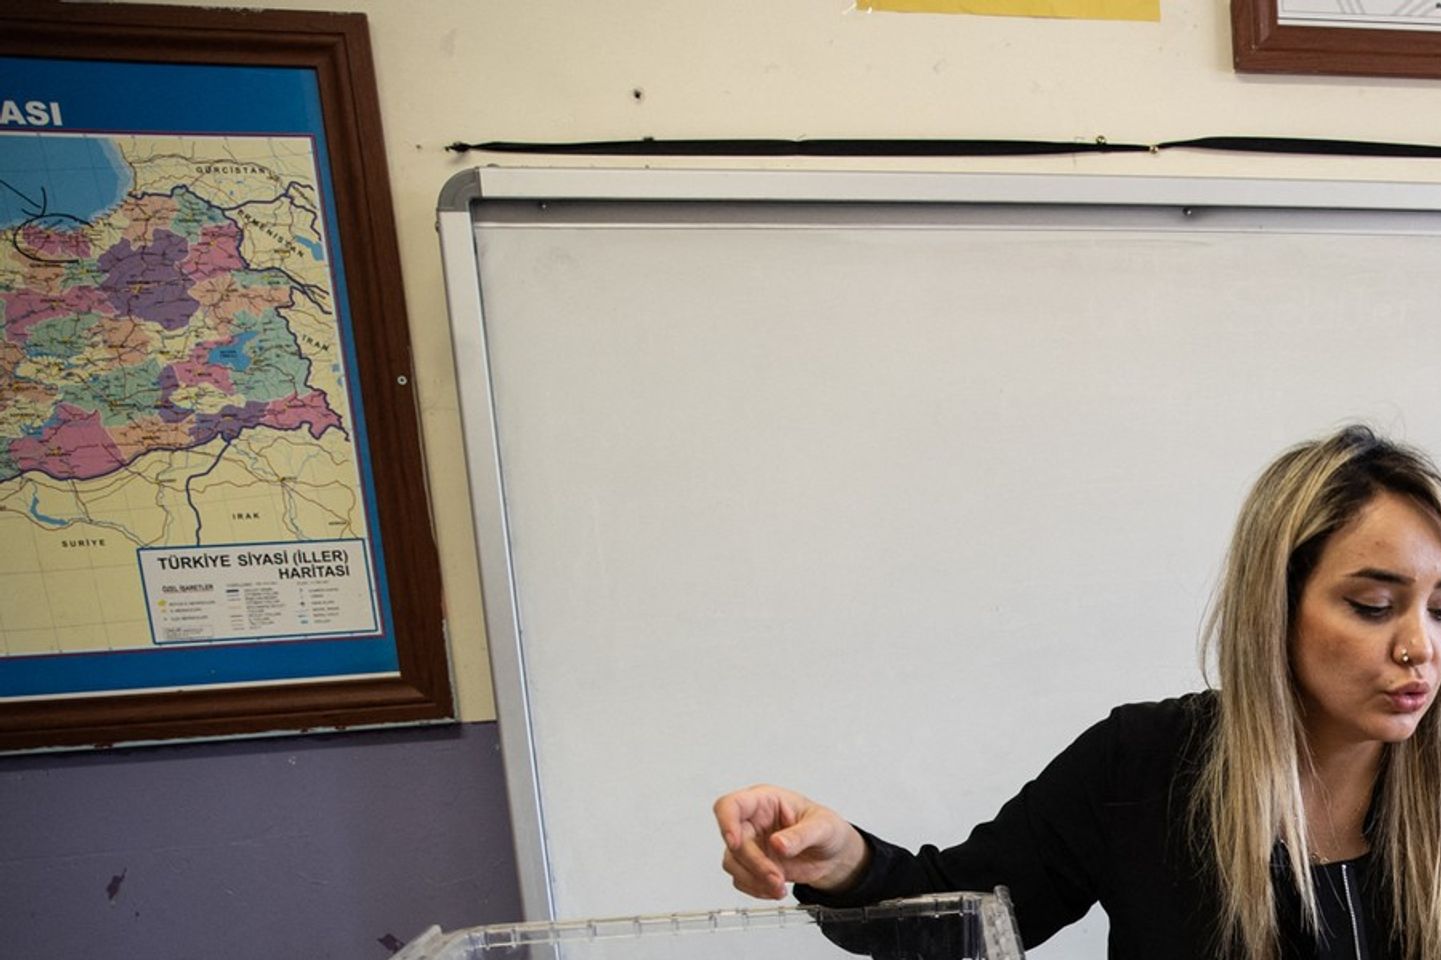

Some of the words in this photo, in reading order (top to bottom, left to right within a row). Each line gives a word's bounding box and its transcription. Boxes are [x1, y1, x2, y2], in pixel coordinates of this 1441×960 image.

[0, 100, 63, 126] ASI
[232, 512, 260, 520] IRAK
[158, 553, 231, 571] TÜRKİYE
[238, 550, 288, 567] SİYASİ
[293, 549, 349, 566] (İLLER)
[278, 565, 350, 580] HARİTASI
